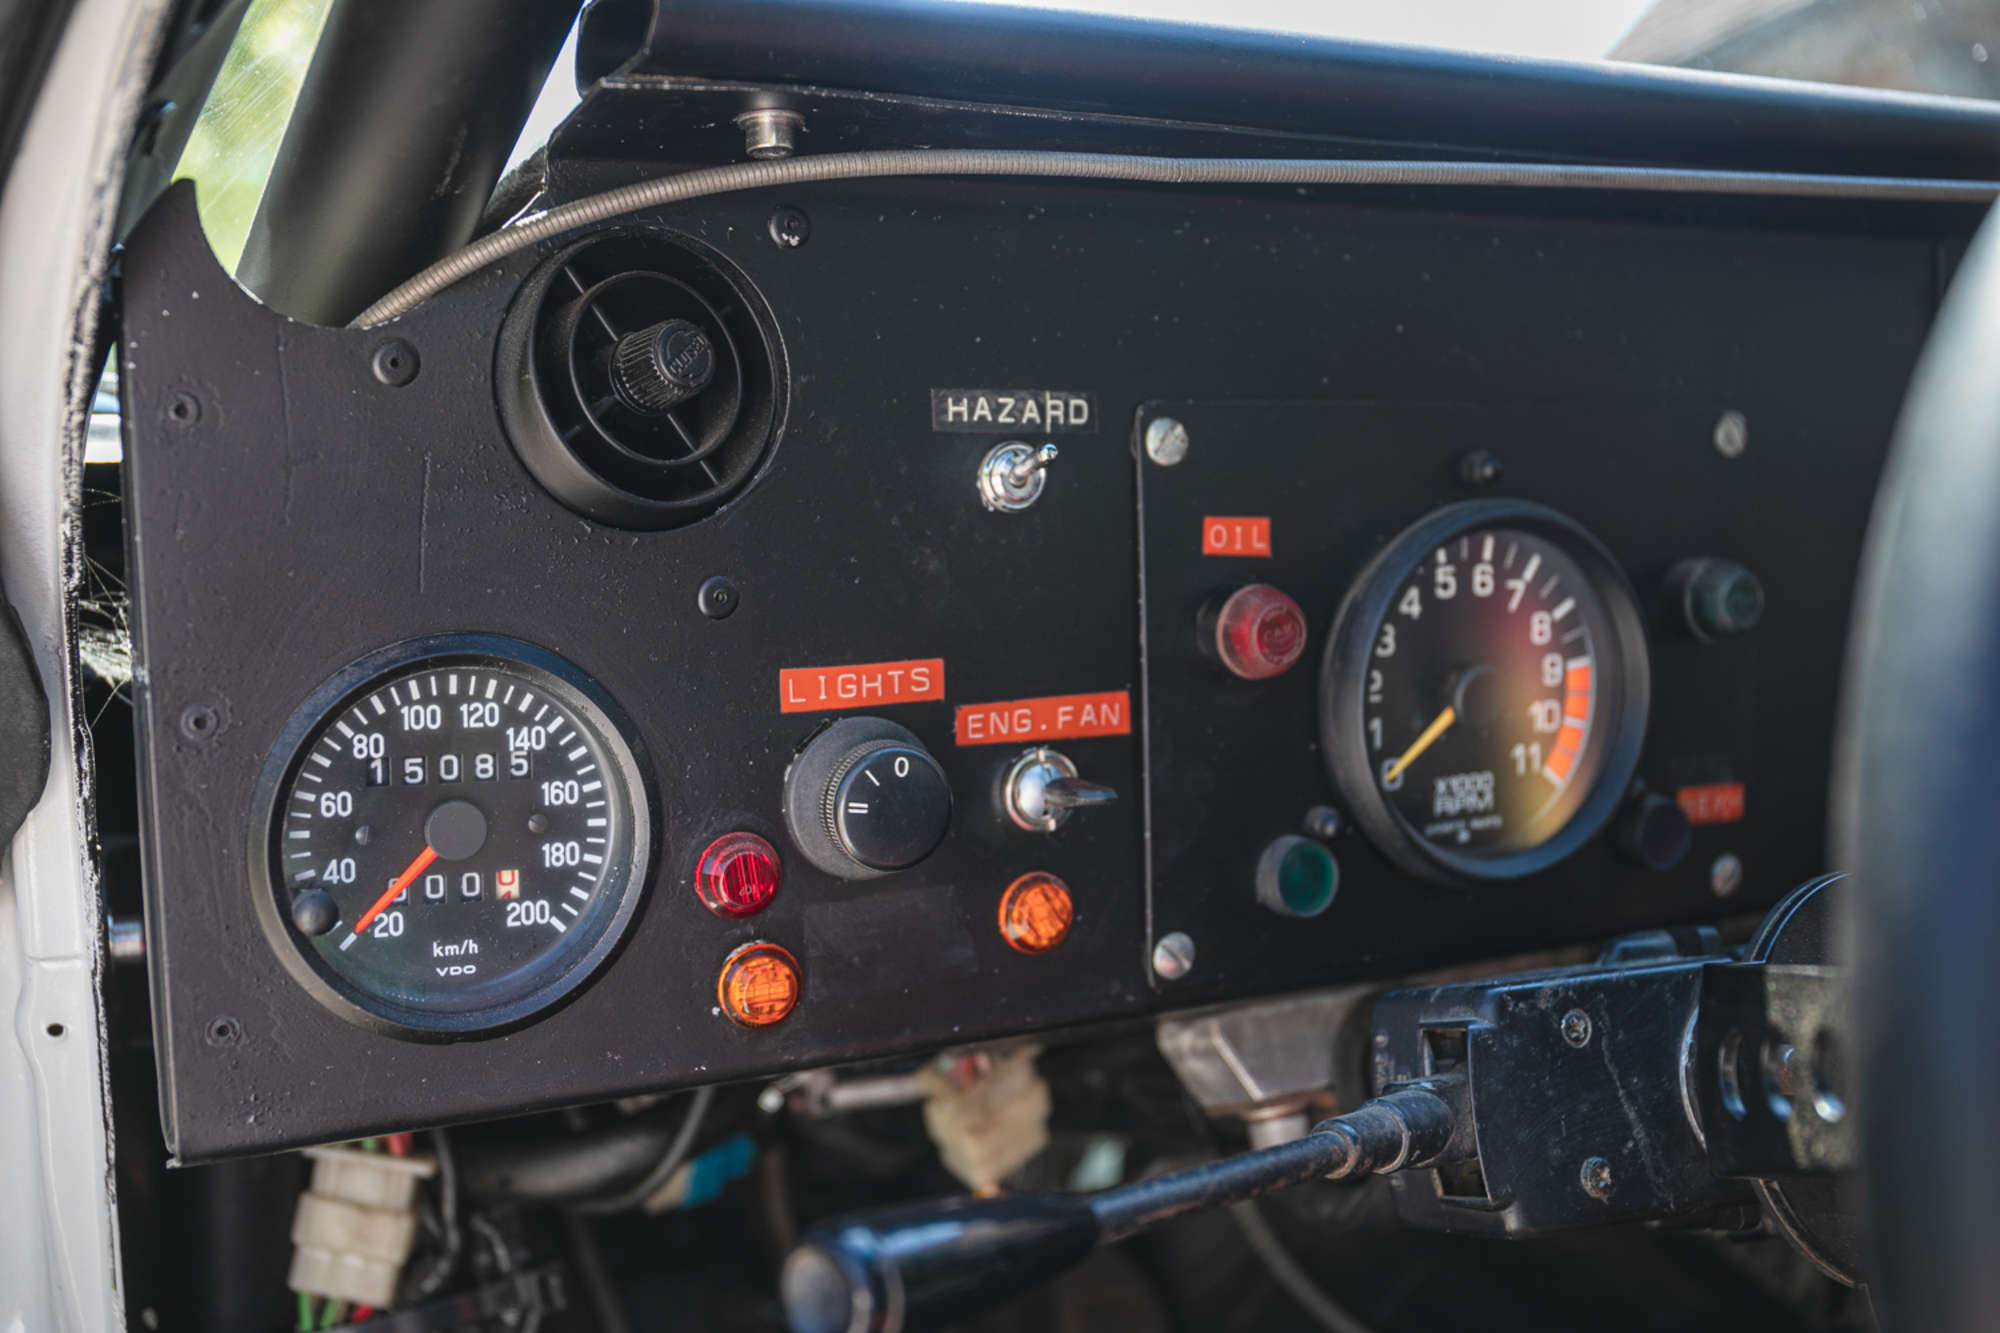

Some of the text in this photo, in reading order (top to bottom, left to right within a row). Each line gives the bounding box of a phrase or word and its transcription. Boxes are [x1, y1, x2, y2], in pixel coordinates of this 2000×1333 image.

[947, 397, 1089, 425] HAZARD
[1208, 524, 1267, 551] OIL
[1435, 565, 1456, 599] 5
[1472, 564, 1494, 597] 6
[1398, 586, 1421, 619] 4
[1505, 579, 1526, 612] 7
[1375, 623, 1395, 657] 3
[1530, 611, 1551, 645] 8
[1542, 653, 1563, 686] 9
[788, 667, 931, 703] LIGHTS
[400, 704, 442, 730] 100
[459, 702, 500, 728] 120
[967, 703, 1121, 740] ENG.FAN
[1528, 699, 1562, 733] 10
[352, 733, 385, 759] 80
[506, 726, 546, 752] 140
[1369, 717, 1383, 749] 1
[1511, 742, 1542, 775] 11
[1381, 758, 1403, 791] 0
[320, 791, 353, 818] 60
[541, 780, 579, 806] 160
[541, 842, 580, 868] 180
[322, 858, 356, 884] 40
[374, 911, 404, 938] 20
[506, 900, 550, 927] 200
[433, 939, 479, 957] km/h
[436, 965, 477, 976] VDO
